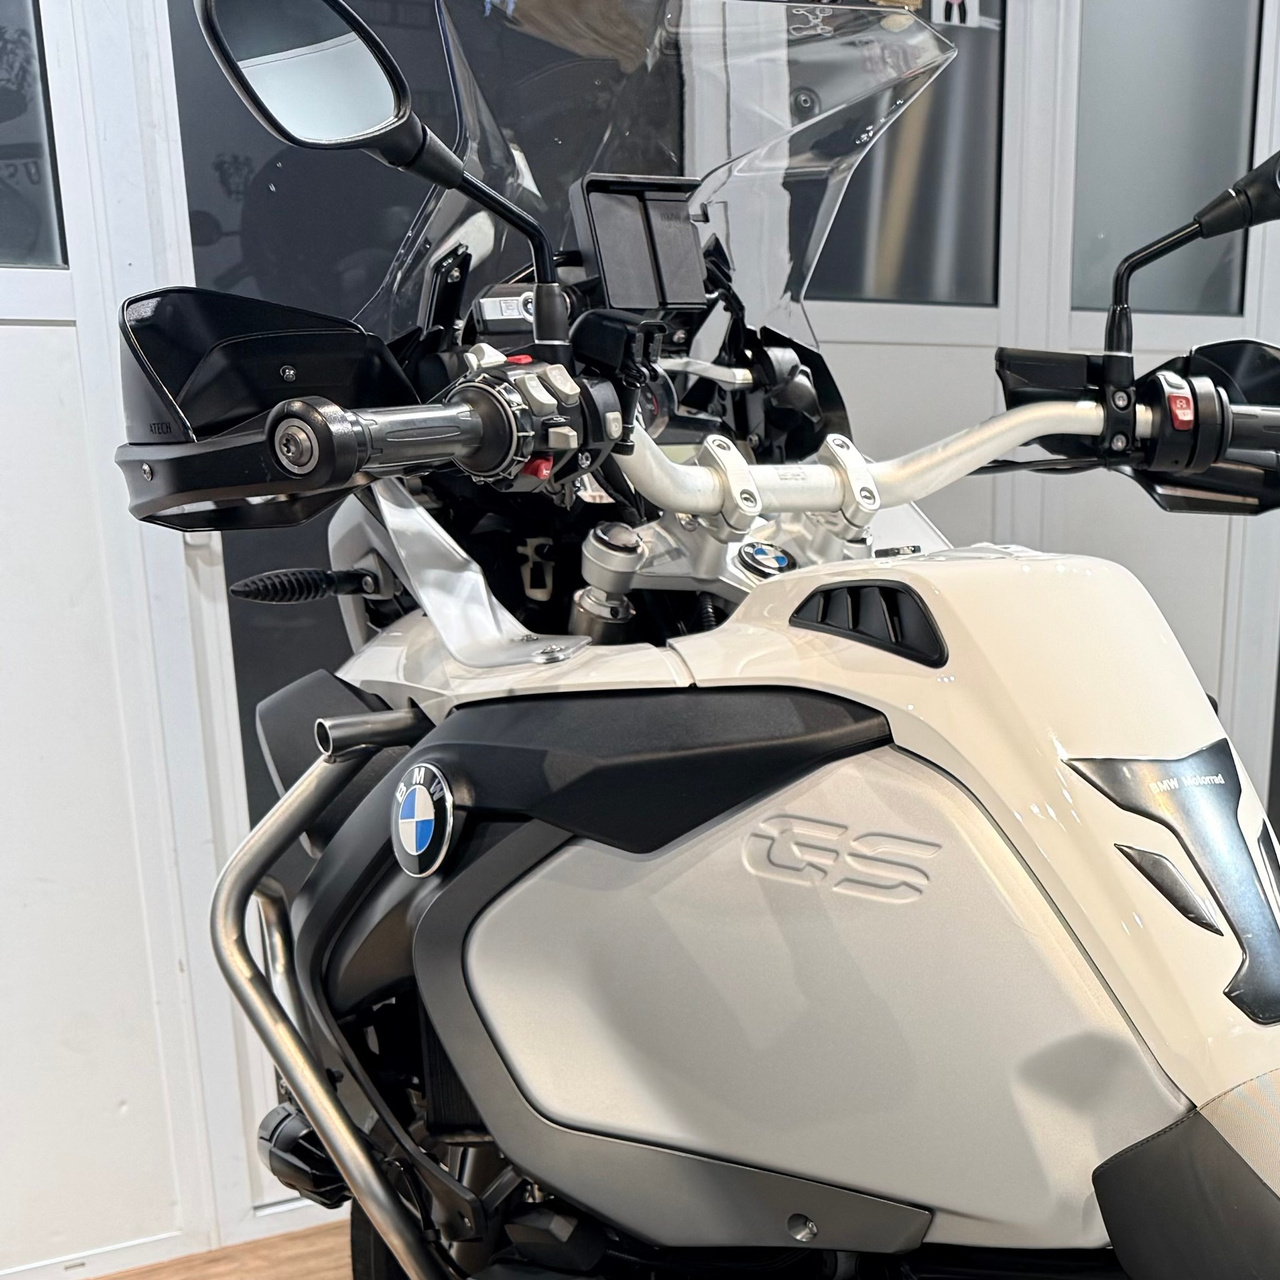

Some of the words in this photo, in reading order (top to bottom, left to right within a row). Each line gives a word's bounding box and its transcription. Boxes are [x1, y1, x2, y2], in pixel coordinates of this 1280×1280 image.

[395, 766, 446, 803] BMW
[1149, 777, 1179, 794] BMW
[1183, 773, 1225, 788] Motorrad
[740, 813, 943, 905] GS
